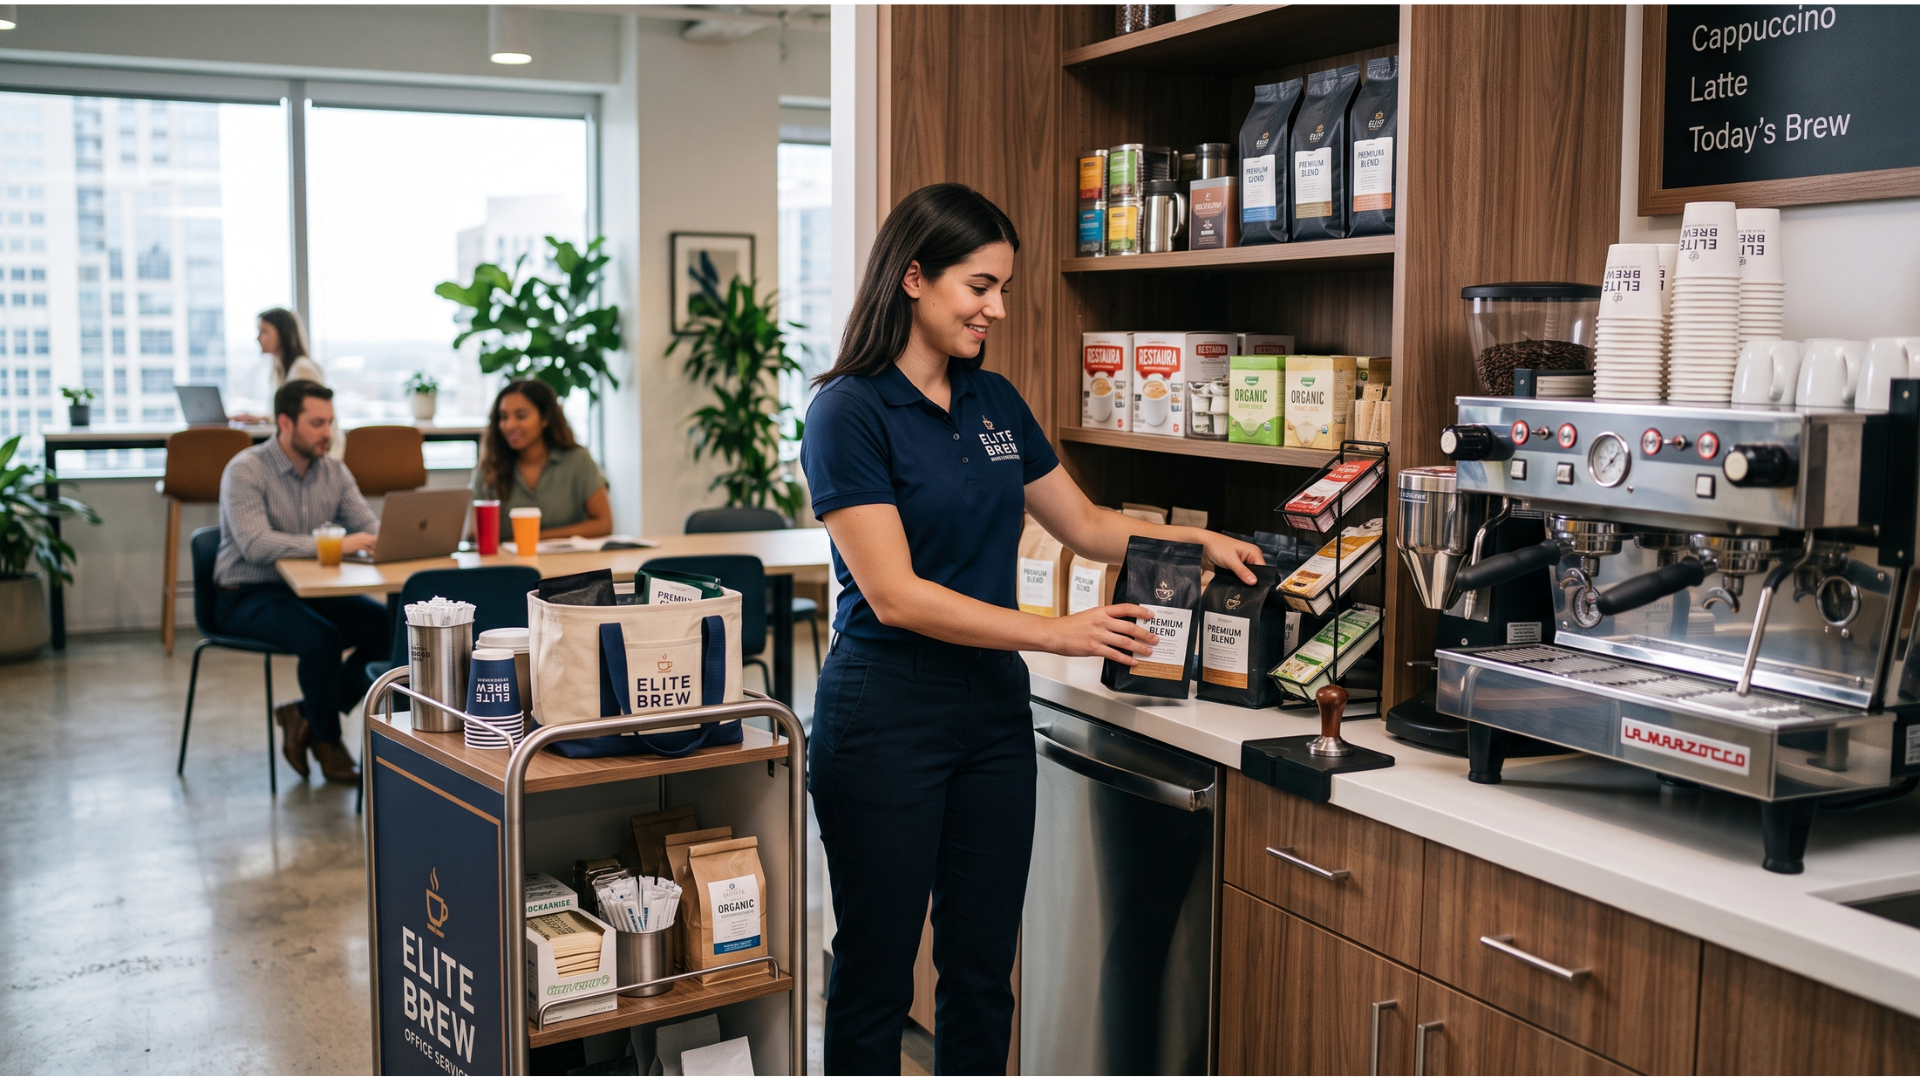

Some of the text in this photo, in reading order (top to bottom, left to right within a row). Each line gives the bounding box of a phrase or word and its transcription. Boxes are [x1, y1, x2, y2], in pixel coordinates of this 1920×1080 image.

[1692, 4, 1836, 54] Cappuccino
[1691, 72, 1748, 102] Latte
[1689, 113, 1851, 154] Today's Brew
[1682, 228, 1718, 239] BREW
[1739, 234, 1765, 243] BRE
[1679, 239, 1717, 251] ELITE
[1606, 270, 1641, 279] BREW
[1603, 280, 1640, 292] ELITE
[1138, 348, 1178, 367] RESTAURA
[1234, 388, 1268, 403] ORGANIC
[1291, 389, 1325, 405] ORGANIC
[978, 429, 1014, 445] ELITE
[984, 442, 1018, 456] BREW
[1144, 617, 1184, 629] PREMIUM
[1207, 624, 1242, 637] PREMIUM
[1149, 626, 1176, 637] BLEND
[1210, 633, 1236, 645] BLEND
[476, 683, 510, 692] BREW
[637, 675, 691, 692] ELITE
[475, 692, 510, 703] ELITE
[637, 690, 691, 708] BREW
[1648, 731, 1745, 768] MARZOCCO
[718, 898, 755, 914] ORGANIC
[402, 925, 475, 1015] ELITE
[403, 976, 476, 1064] BREW
[404, 1028, 433, 1060] OFFICE
